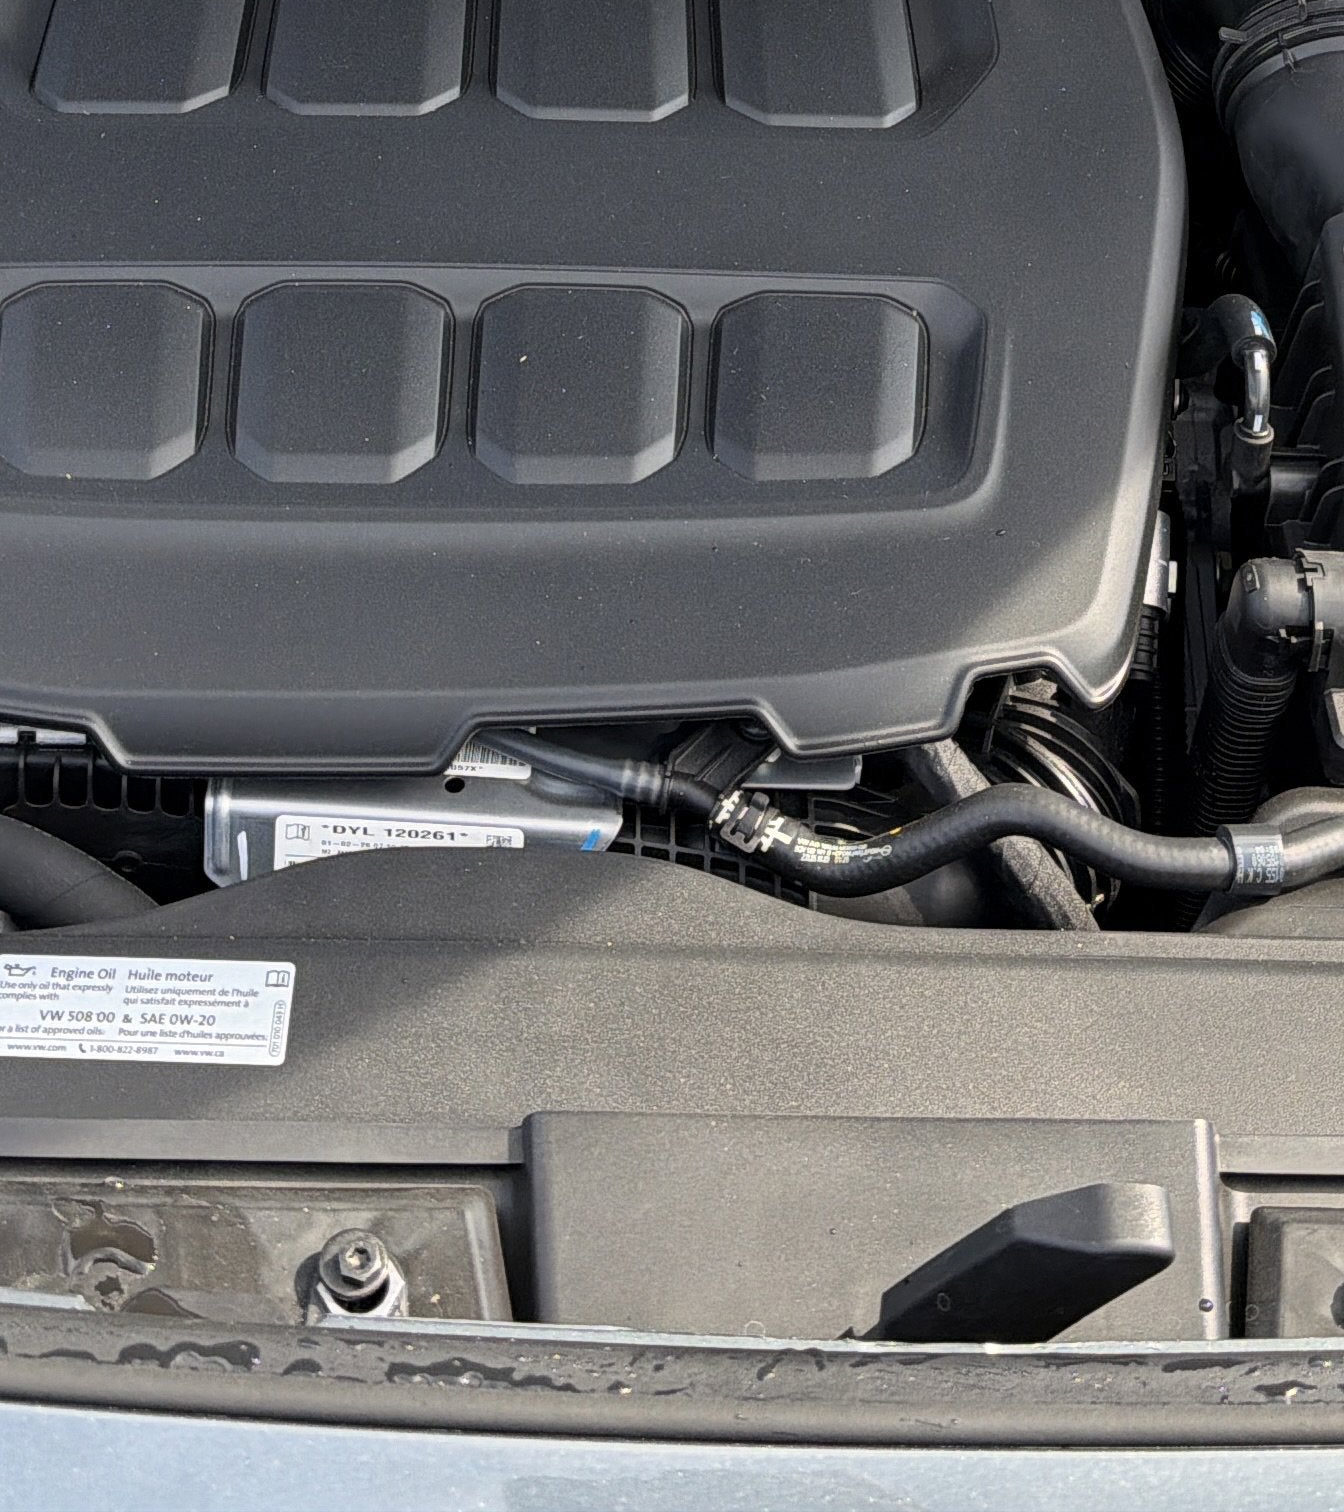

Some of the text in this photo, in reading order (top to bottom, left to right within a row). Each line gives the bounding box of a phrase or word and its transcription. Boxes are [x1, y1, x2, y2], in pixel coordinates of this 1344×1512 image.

[51, 966, 117, 981] Engine Oil
[127, 968, 214, 983] Huile moteur
[0, 980, 113, 994] Use only oil that expressly
[124, 985, 259, 998] Utilisez uniquement de l'huile
[38, 992, 59, 1001] with
[122, 997, 138, 1006] qui
[140, 997, 176, 1006] satisfait
[40, 1009, 216, 1026] VW 508 00 & SAE 0W-20
[15, 1024, 29, 1033] list
[30, 1024, 42, 1034] of
[41, 1026, 85, 1037] approved
[118, 1028, 139, 1037] Pour
[140, 1030, 158, 1038] une
[159, 1029, 177, 1038] liste
[178, 1030, 212, 1039] d'huiles
[7, 1044, 225, 1057] www.vw.com 1-800-822-8987 www.vw.ca
